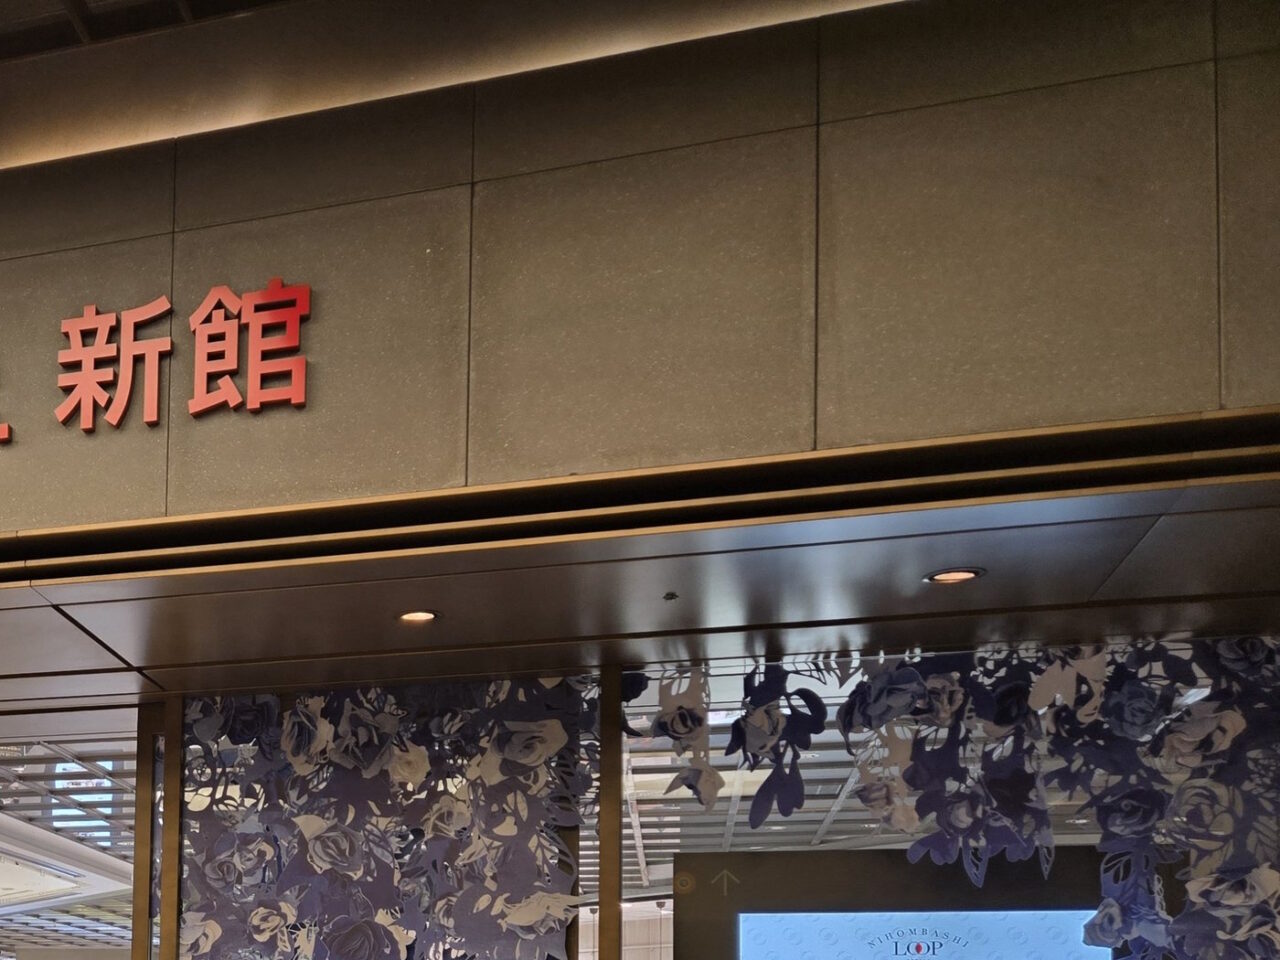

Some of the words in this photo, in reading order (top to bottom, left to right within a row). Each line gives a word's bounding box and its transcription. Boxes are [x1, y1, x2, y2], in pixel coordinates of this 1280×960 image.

[54, 275, 312, 433] 新館
[867, 927, 969, 949] NIHOMBASHI
[892, 941, 944, 956] LOOP
